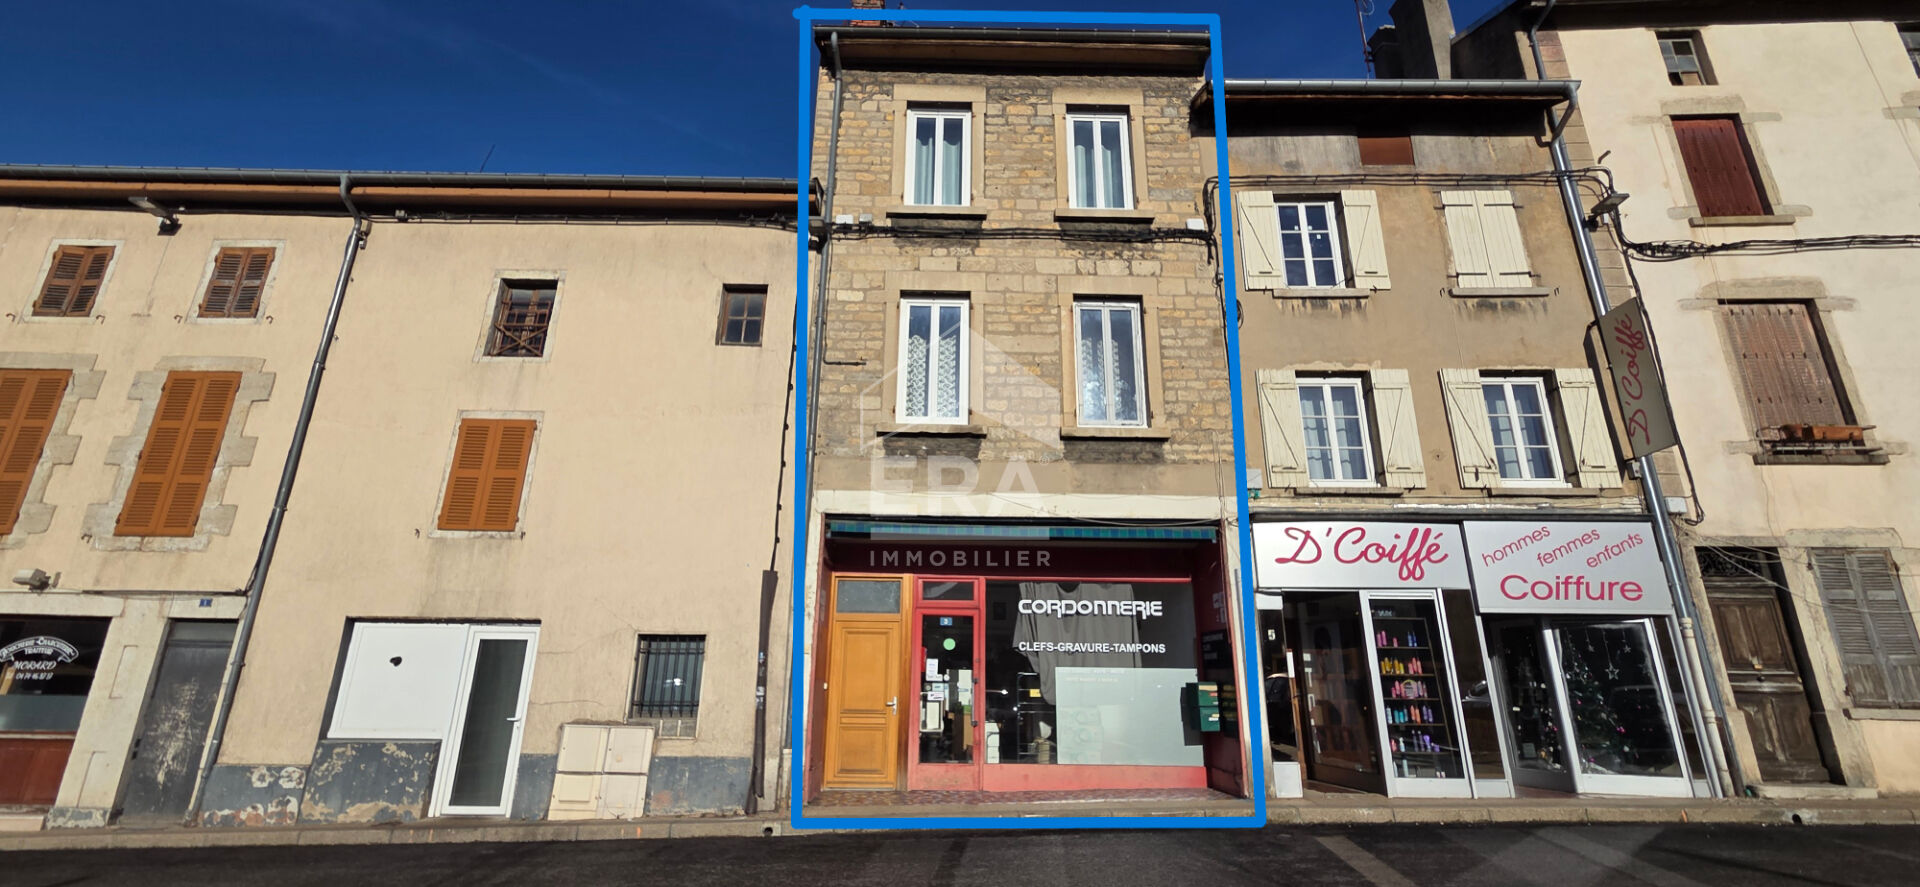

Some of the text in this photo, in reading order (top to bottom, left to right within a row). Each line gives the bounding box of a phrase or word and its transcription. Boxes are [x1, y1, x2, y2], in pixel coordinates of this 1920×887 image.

[1614, 313, 1650, 445] D'Coiffé
[1275, 527, 1448, 581] D'Coiffé
[1482, 526, 1550, 567] hommes
[1536, 529, 1600, 567] femmes
[1586, 533, 1643, 568] enfants
[1500, 574, 1643, 601] Coiffure
[1018, 599, 1163, 620] CORDONNERIE
[1018, 641, 1166, 654] CLEFS-GRAVURE-TAMPONS
[1267, 629, 1276, 641] 5
